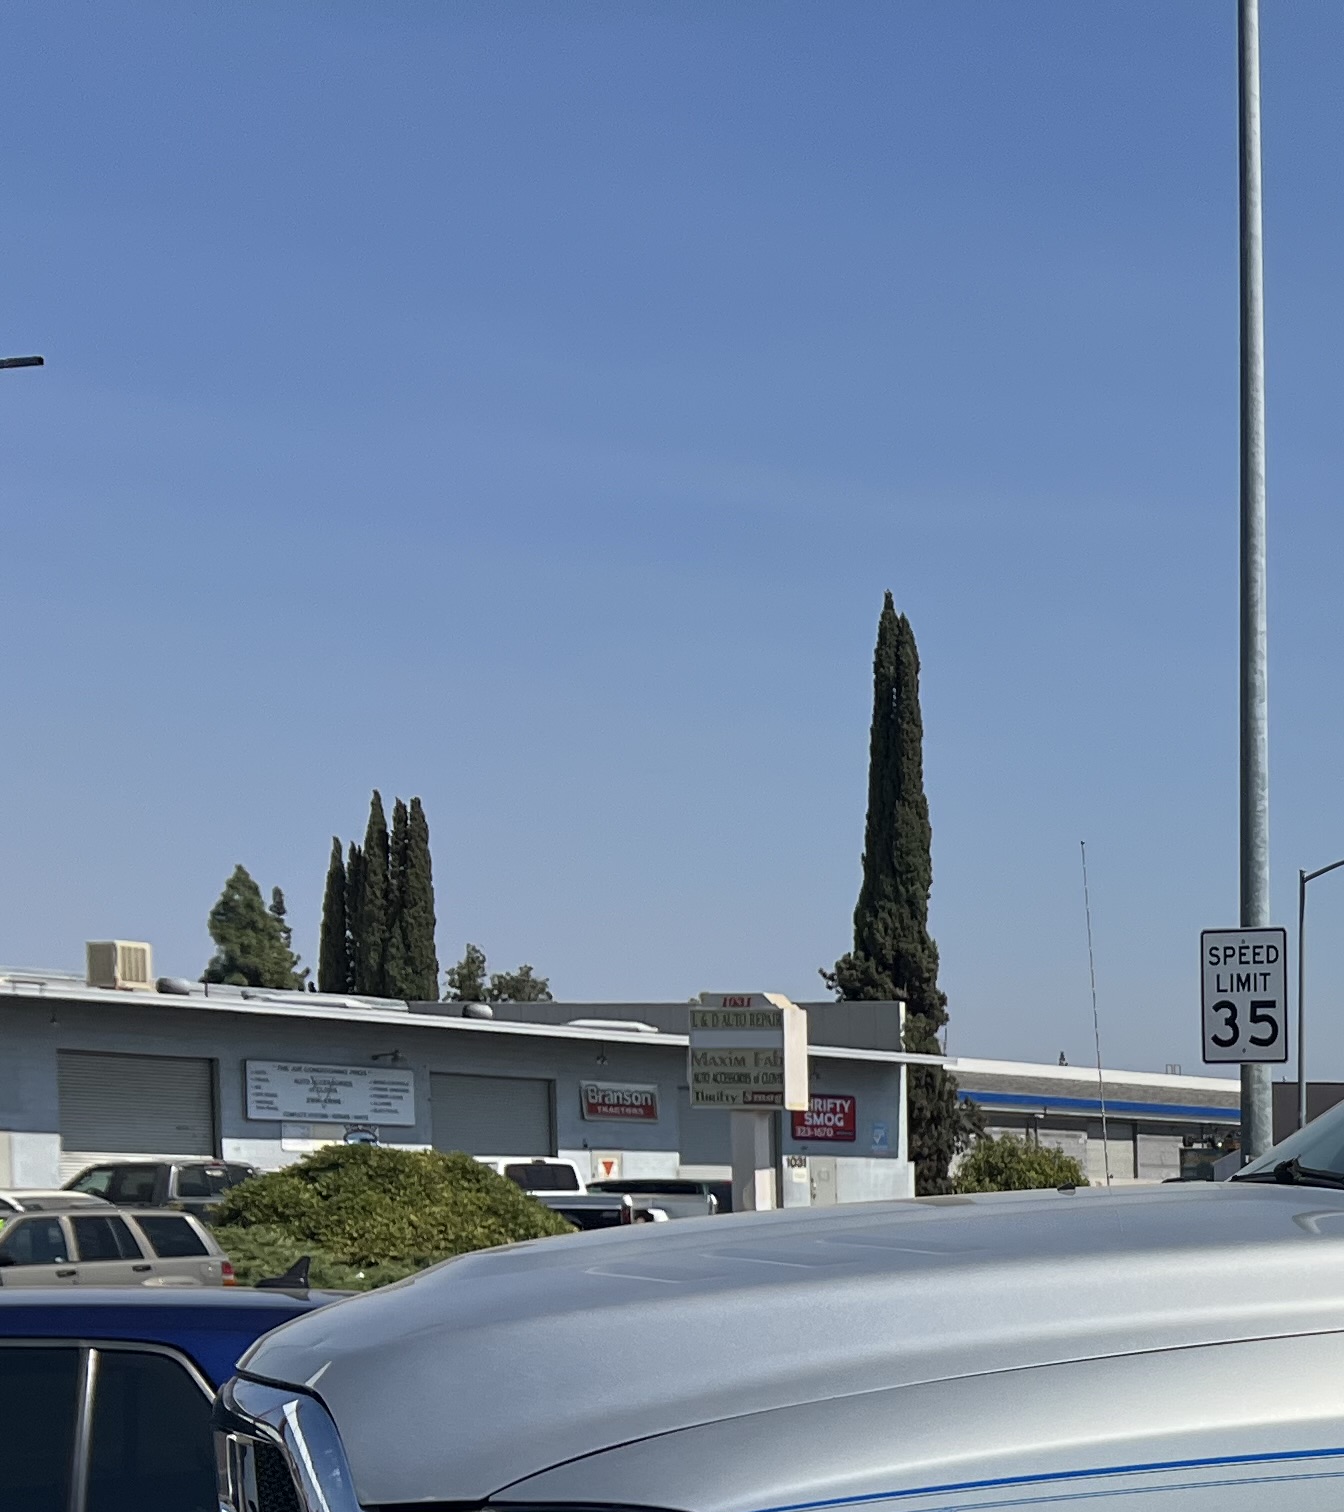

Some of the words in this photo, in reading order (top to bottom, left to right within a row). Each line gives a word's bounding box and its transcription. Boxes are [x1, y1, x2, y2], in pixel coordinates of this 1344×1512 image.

[1208, 945, 1279, 966] SPEED
[1216, 972, 1271, 993] LIMIT
[722, 996, 752, 1008] 1031
[721, 1011, 747, 1028] AUTO
[1211, 1000, 1279, 1048] 35
[586, 1084, 652, 1106] Branson
[803, 1111, 844, 1127] SMOG
